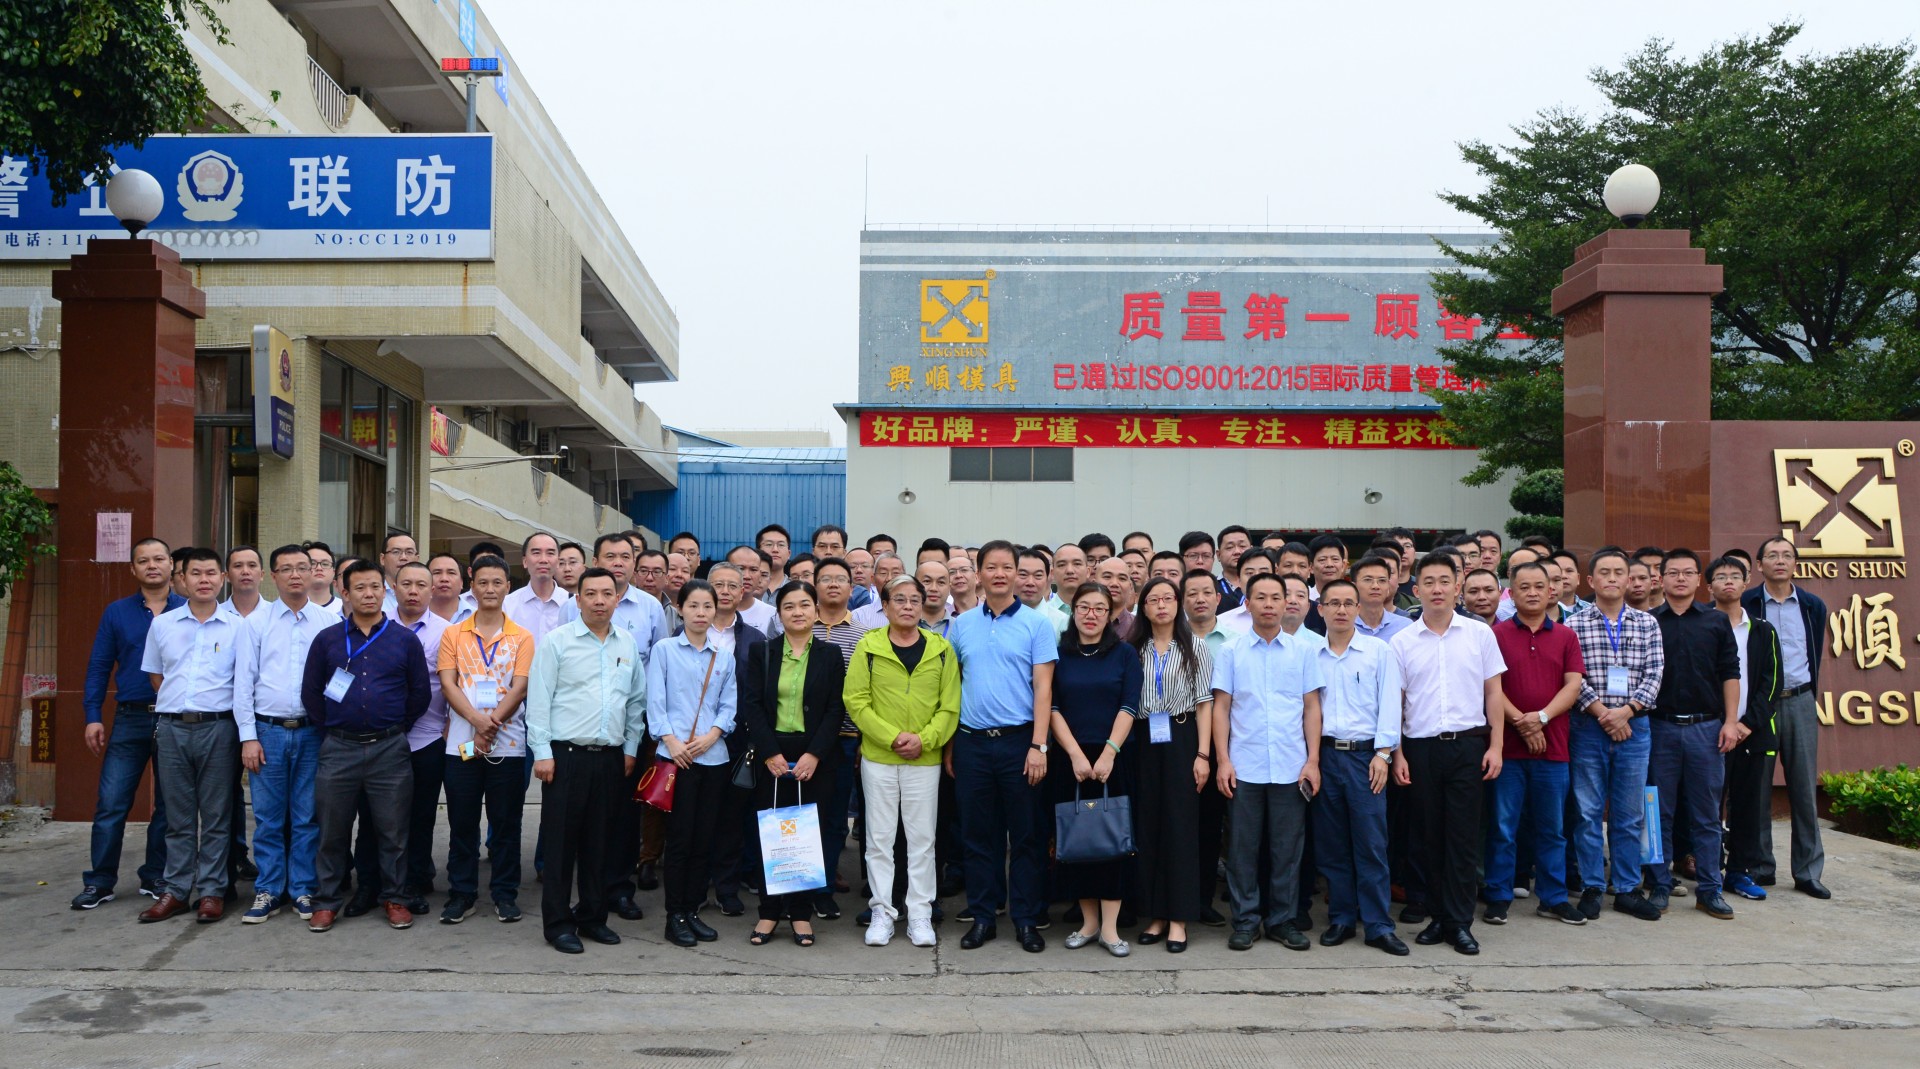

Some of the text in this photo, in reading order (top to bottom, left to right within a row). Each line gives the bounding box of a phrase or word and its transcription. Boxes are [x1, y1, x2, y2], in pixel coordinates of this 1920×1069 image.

[314, 233, 457, 246] NO:CC12019
[921, 346, 988, 358] XING SHUN
[1849, 561, 1907, 579] SHUN
